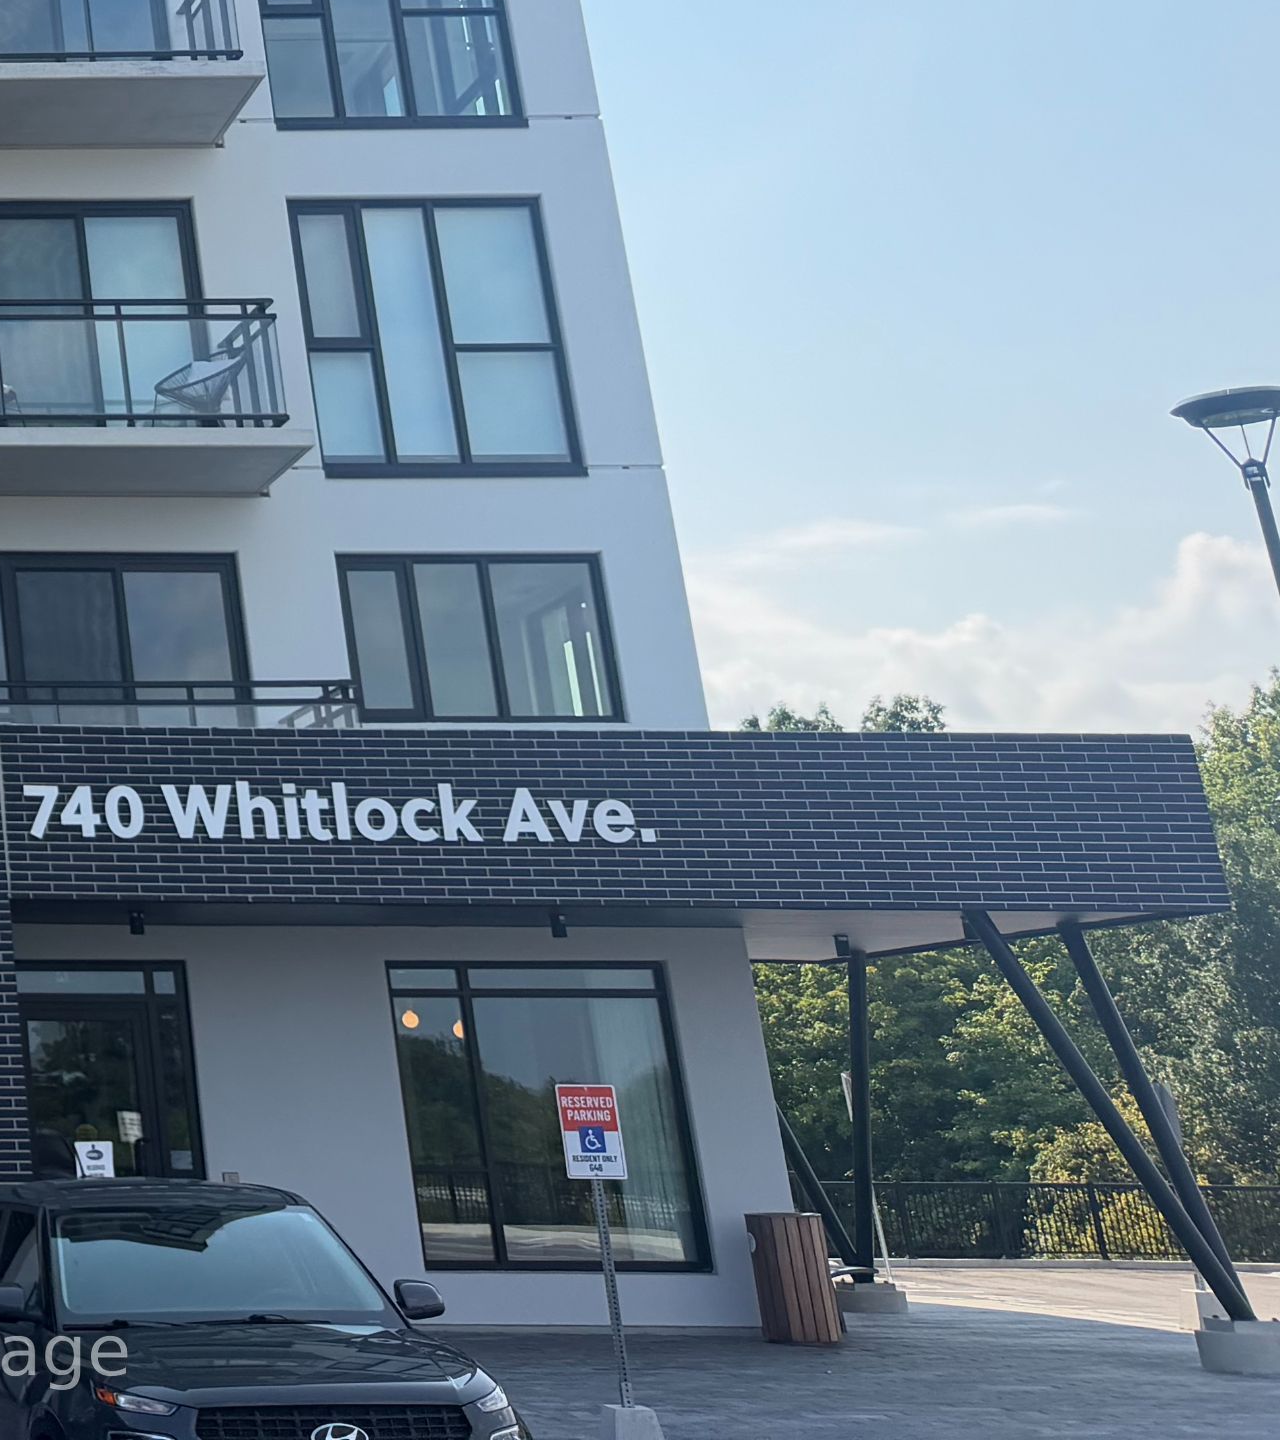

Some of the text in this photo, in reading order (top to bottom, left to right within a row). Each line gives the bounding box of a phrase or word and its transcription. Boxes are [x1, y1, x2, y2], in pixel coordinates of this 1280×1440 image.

[24, 781, 657, 843] 740 Whitlock Ave.
[560, 1096, 613, 1108] RESERVED
[567, 1110, 611, 1121] PARKING
